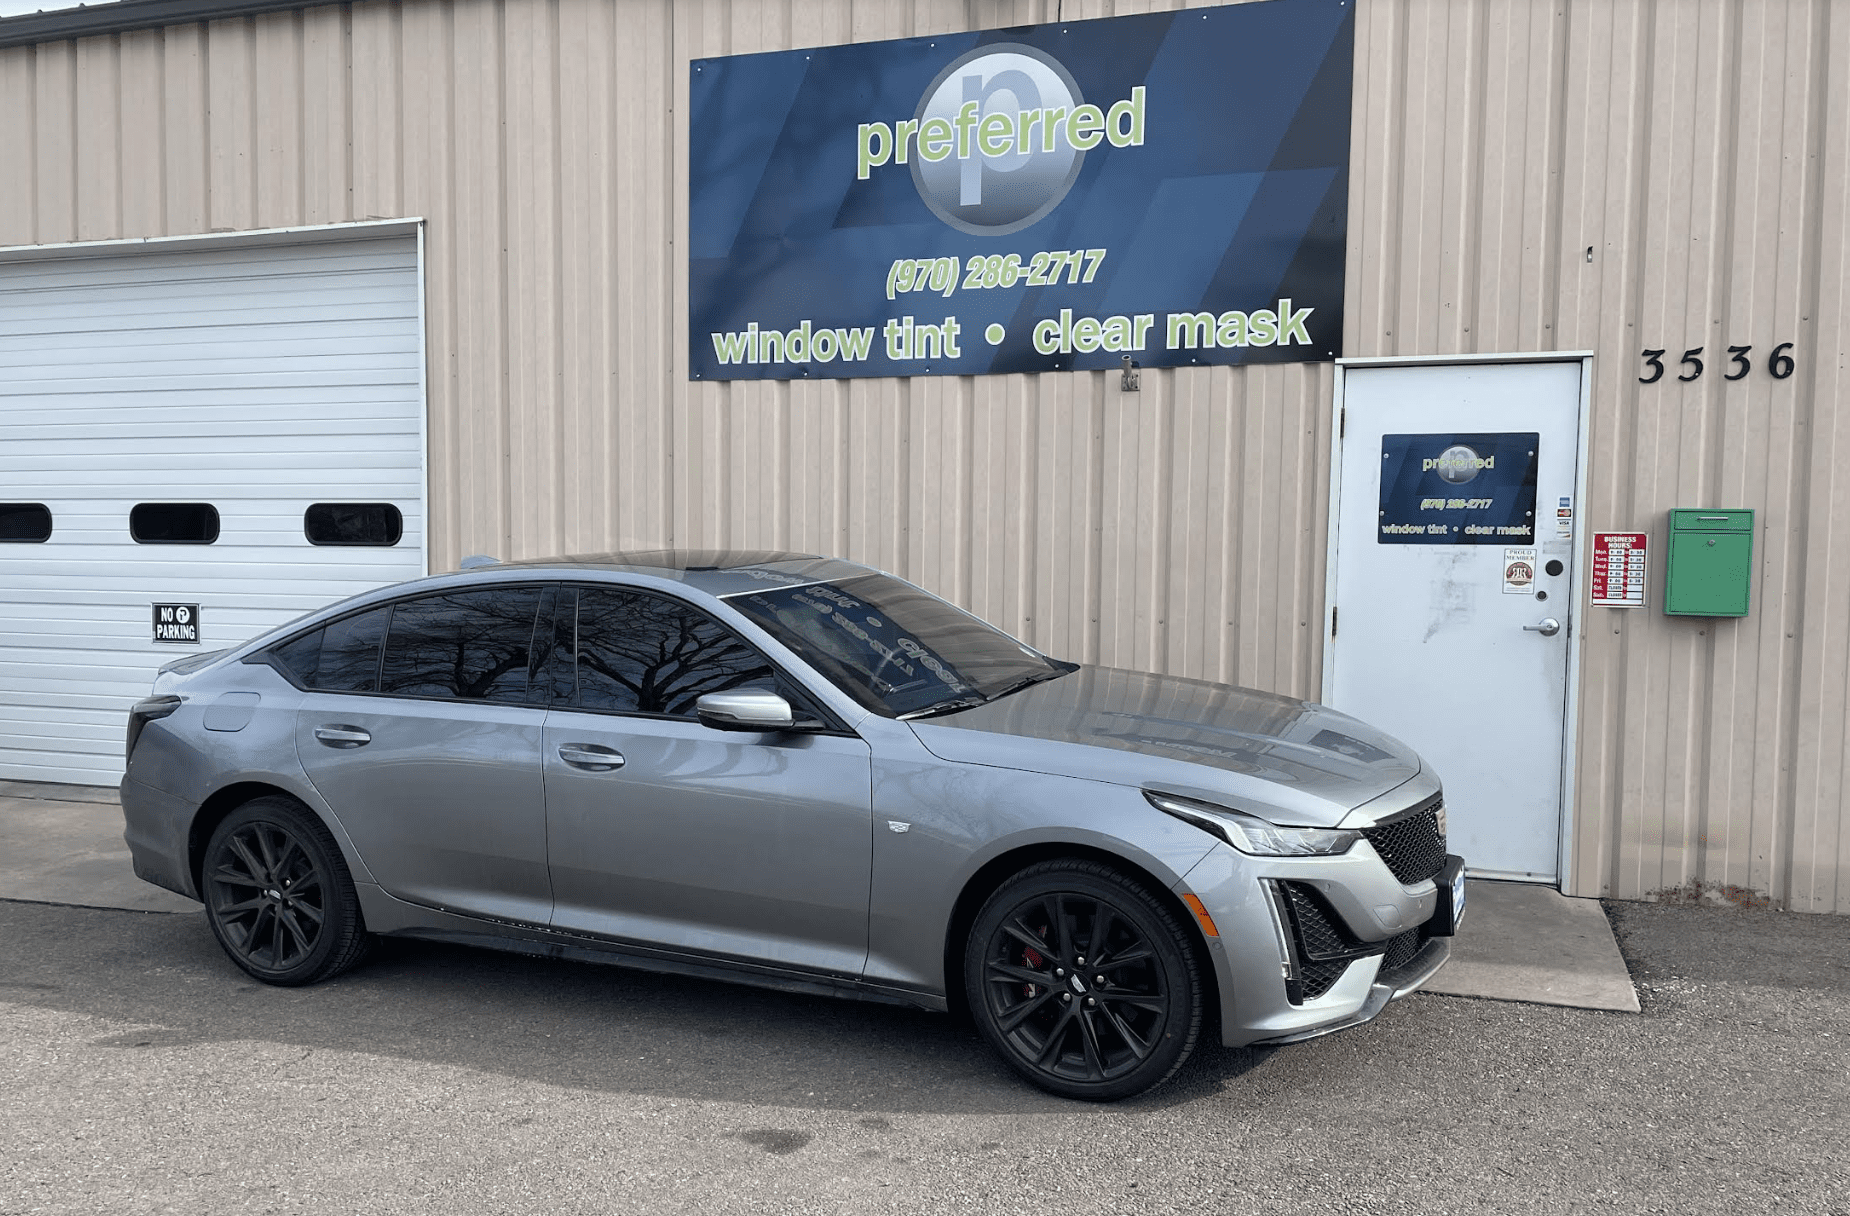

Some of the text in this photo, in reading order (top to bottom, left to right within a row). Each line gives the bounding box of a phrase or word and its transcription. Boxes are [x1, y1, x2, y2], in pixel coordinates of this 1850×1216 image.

[856, 86, 1147, 180] preferred
[886, 248, 1107, 300] (970) 286-2717
[711, 298, 1315, 365] window tint clear mask
[1638, 342, 1795, 384] 3536
[1422, 455, 1495, 472] preferred
[1381, 523, 1531, 536] window tint clear mask
[161, 607, 173, 622] NO
[156, 624, 196, 640] PARKING
